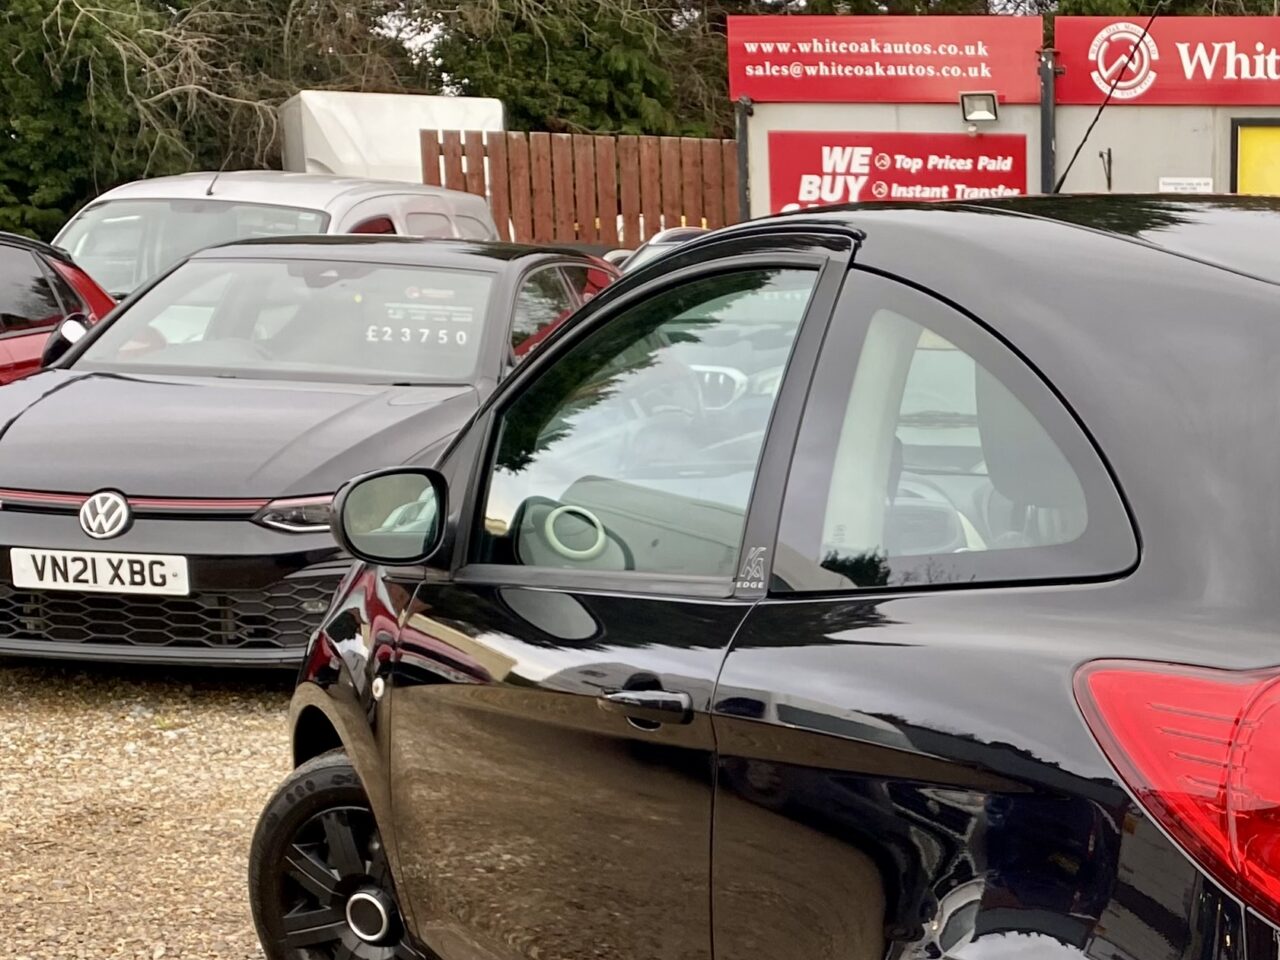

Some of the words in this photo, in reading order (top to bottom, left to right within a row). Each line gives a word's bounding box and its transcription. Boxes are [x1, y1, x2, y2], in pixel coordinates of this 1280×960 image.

[744, 39, 988, 56] www.whiteoakautos.co.uk
[745, 61, 992, 78] sales@whiteoakautos.co.uk
[821, 146, 873, 173] WE
[893, 155, 923, 173] Top
[927, 155, 972, 171] Prices
[977, 156, 1013, 171] Paid
[798, 174, 869, 202] BUY
[890, 182, 950, 198] Instant
[954, 183, 1020, 200] Transfer
[366, 325, 467, 345] £23750
[30, 553, 98, 585] VN21
[106, 557, 167, 587] XBG
